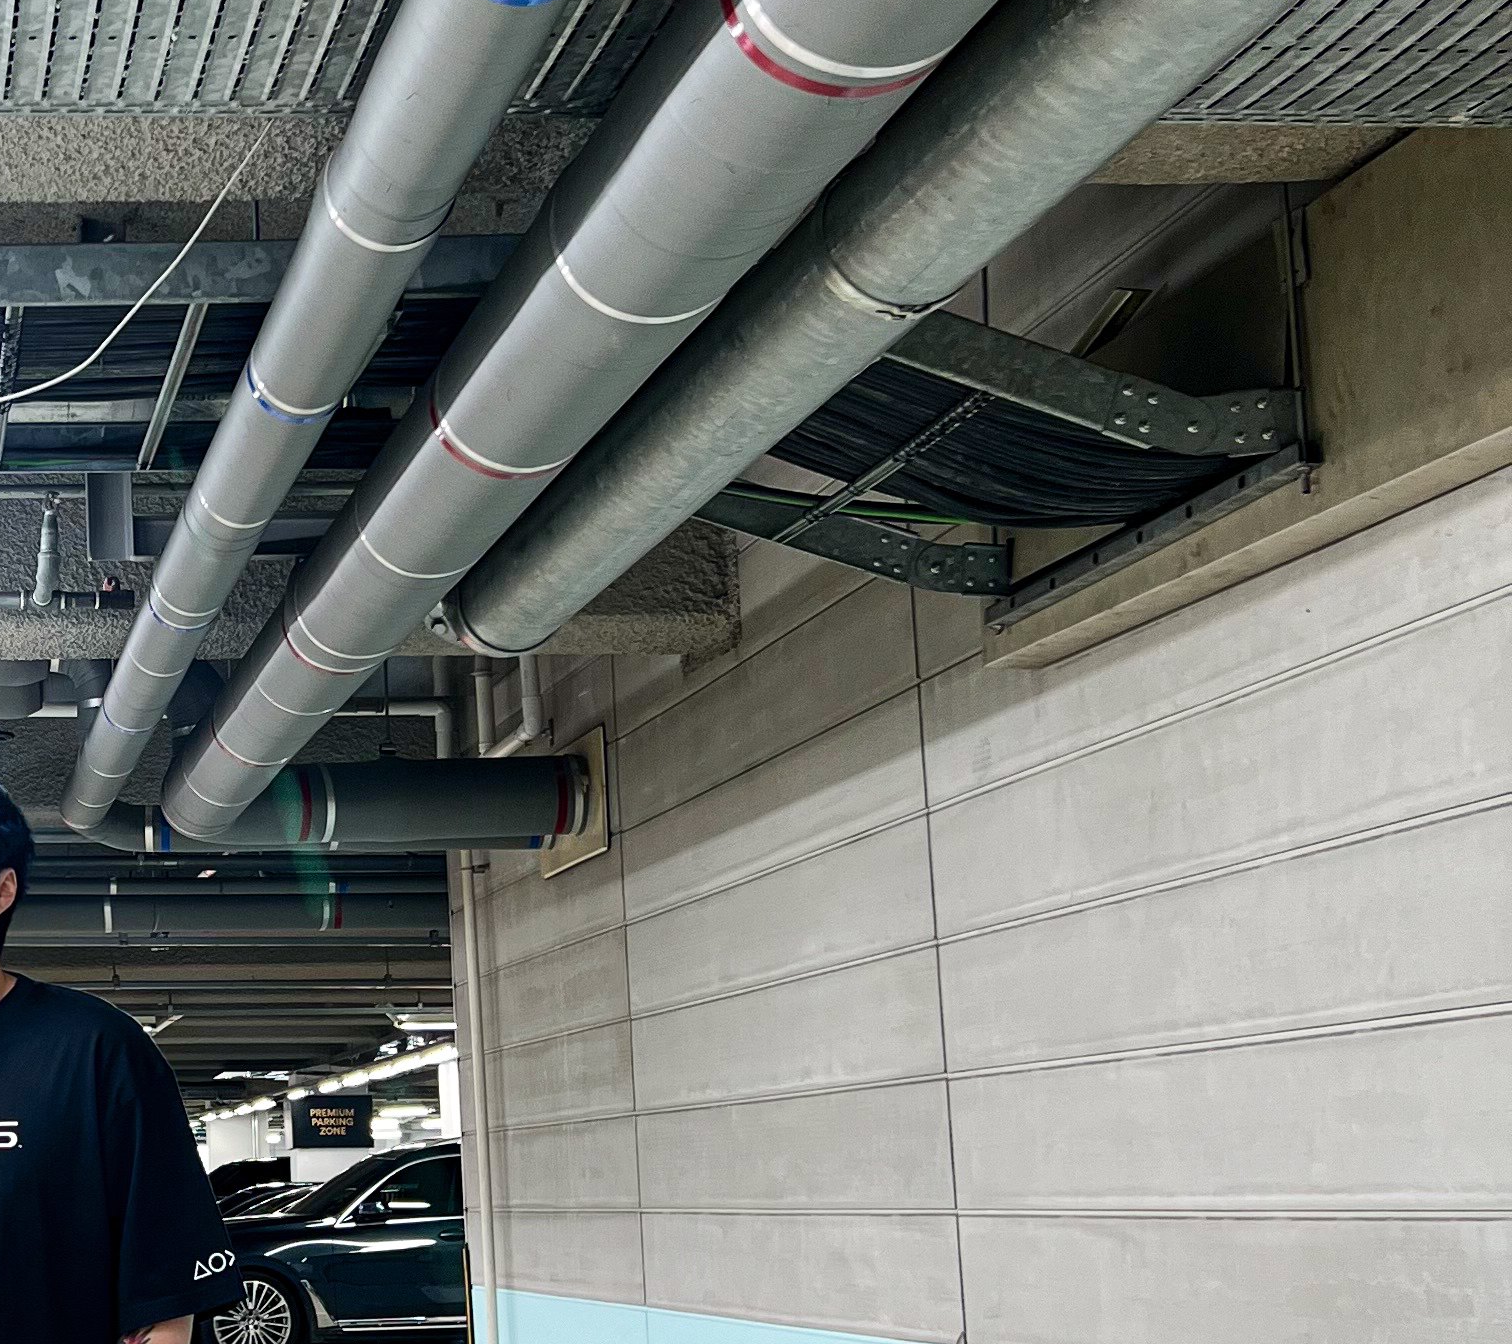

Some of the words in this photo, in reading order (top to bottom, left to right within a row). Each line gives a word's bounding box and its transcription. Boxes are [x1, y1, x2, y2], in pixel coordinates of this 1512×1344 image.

[309, 1108, 355, 1117] PREMIUM
[311, 1117, 354, 1126] PARKING
[319, 1126, 347, 1136] ZONE
